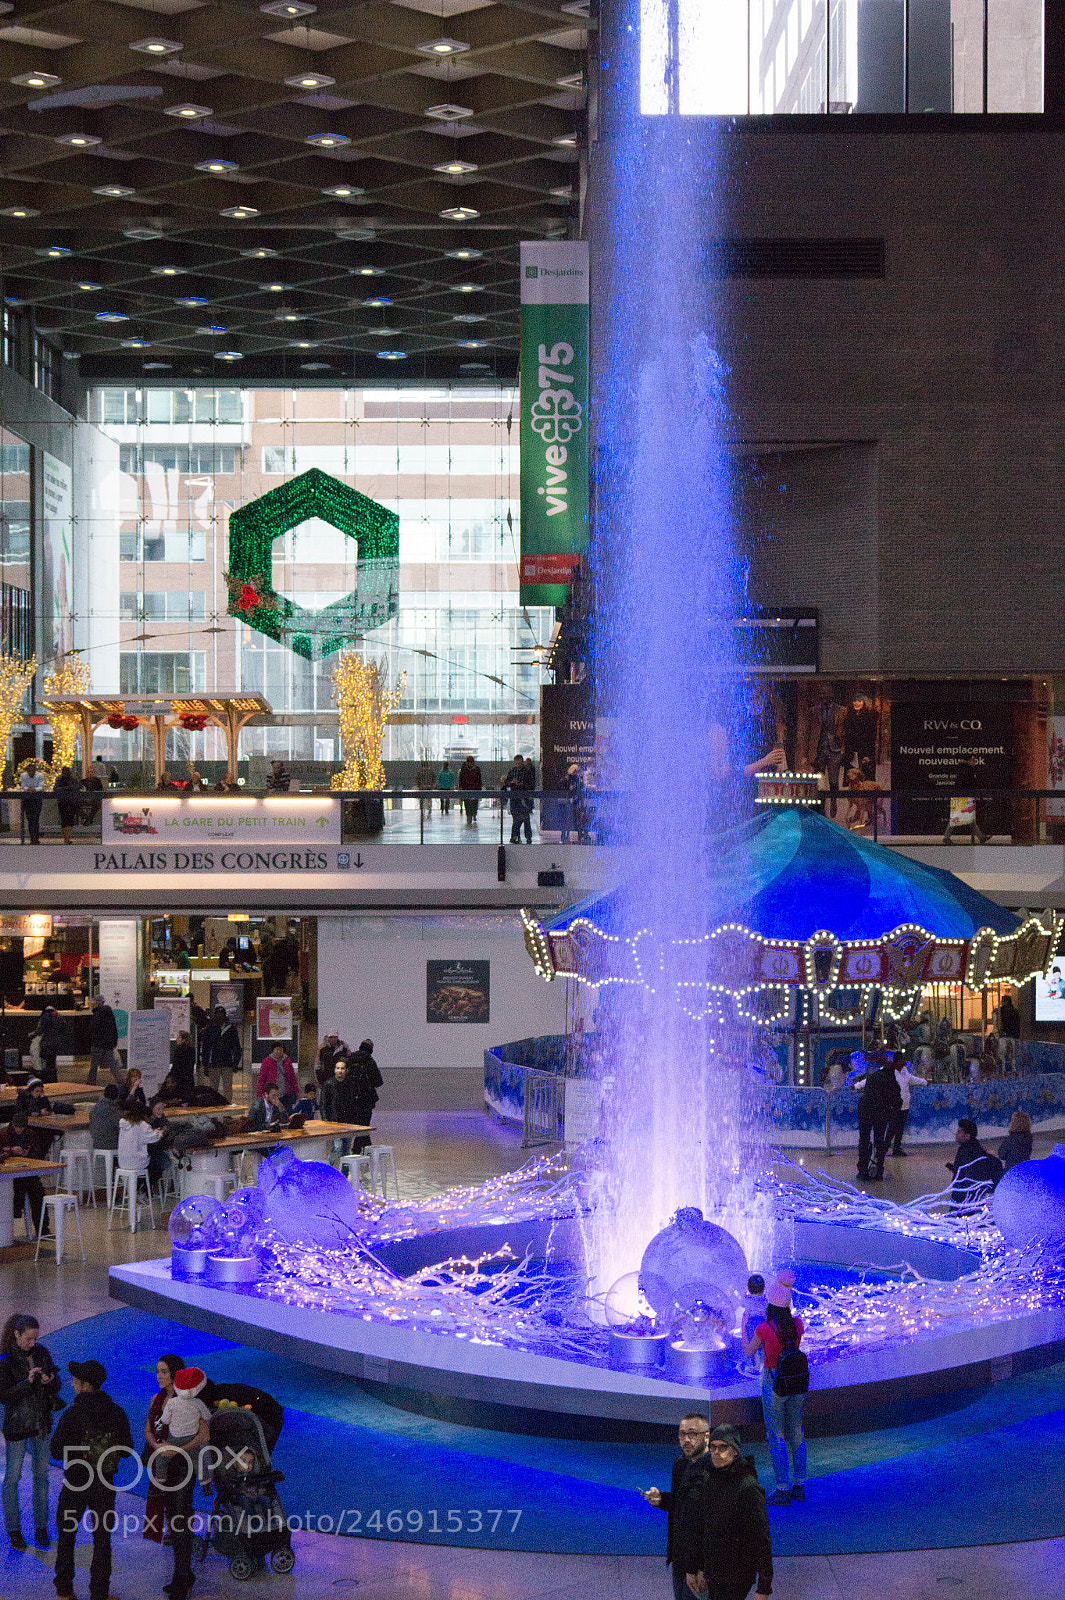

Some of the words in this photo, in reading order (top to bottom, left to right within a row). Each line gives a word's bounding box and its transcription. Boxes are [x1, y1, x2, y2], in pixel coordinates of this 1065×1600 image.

[540, 267, 584, 278] Desjardins
[537, 341, 575, 411] 375
[537, 444, 568, 517] vive
[537, 566, 572, 576] Desjardin
[899, 745, 935, 755] Nouvel
[164, 817, 179, 827] LA
[182, 817, 214, 827] GARE
[217, 817, 234, 827] DU
[238, 817, 267, 827] PETIT
[271, 817, 306, 827] TRAIN
[93, 852, 168, 870] PALAIS
[173, 852, 215, 870] DES
[220, 848, 328, 870] CONGRÈS
